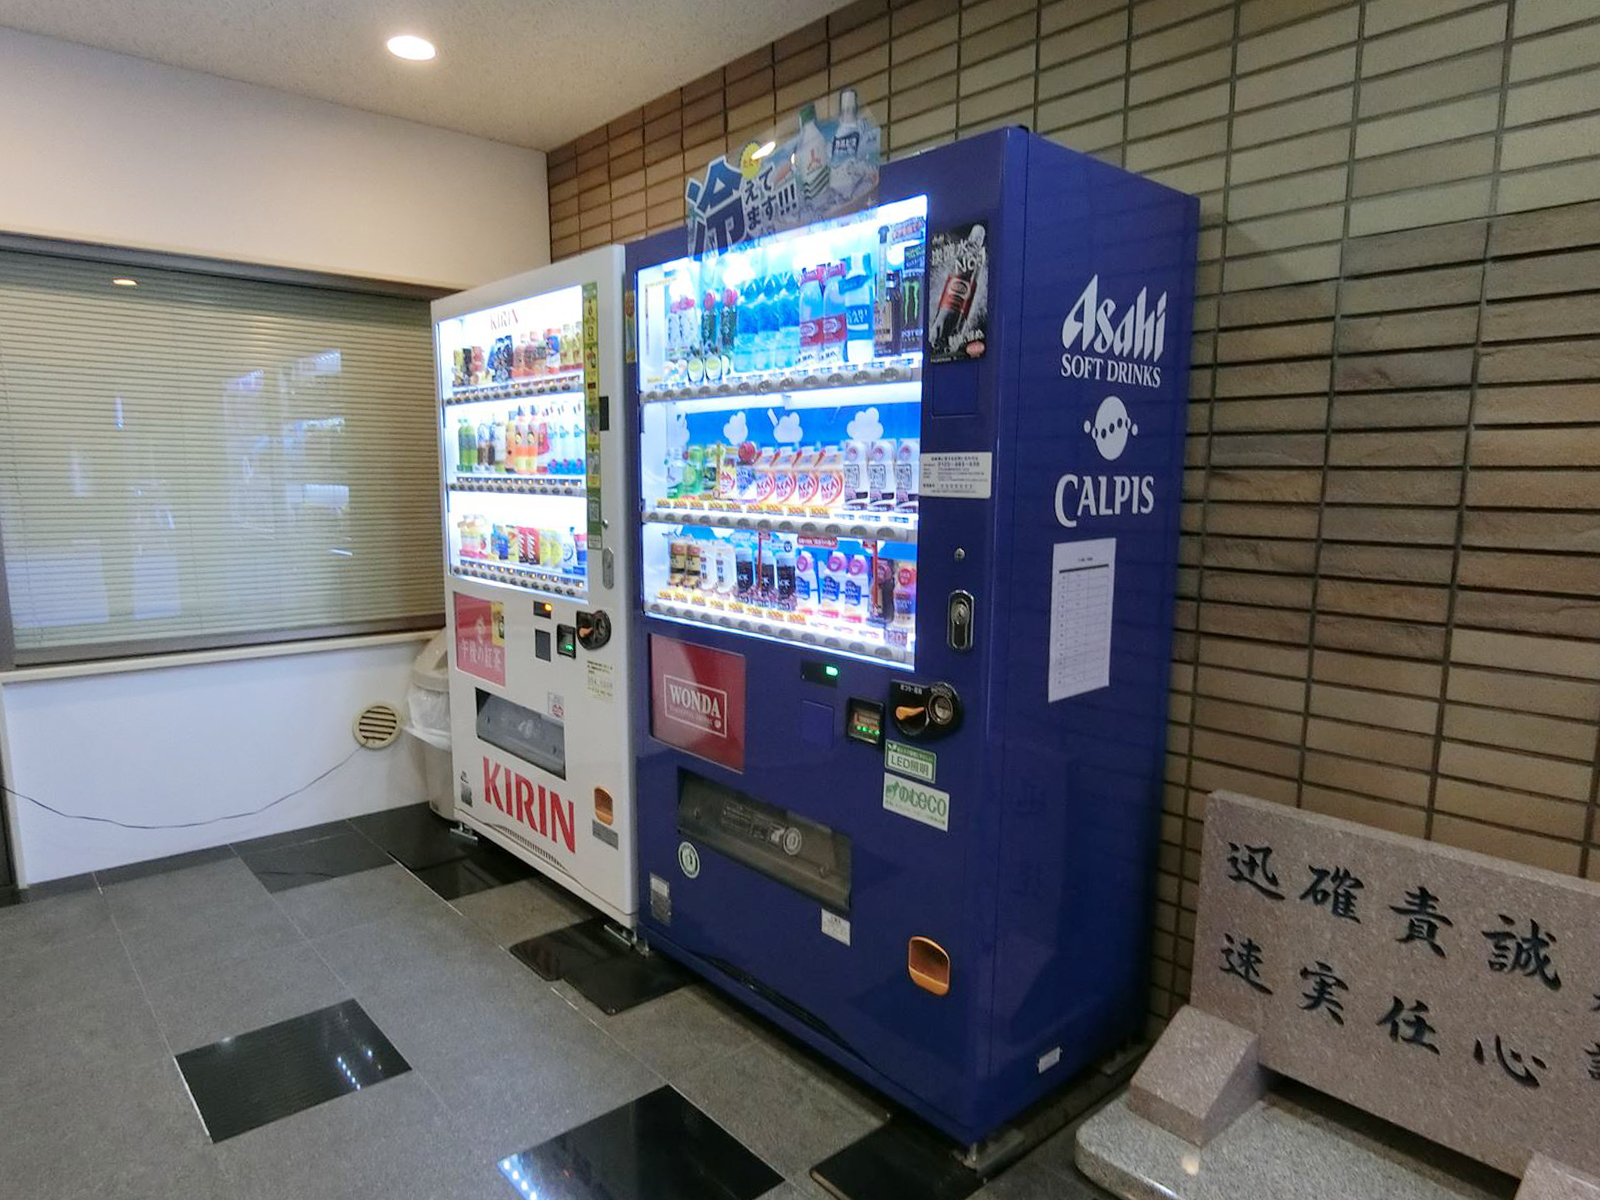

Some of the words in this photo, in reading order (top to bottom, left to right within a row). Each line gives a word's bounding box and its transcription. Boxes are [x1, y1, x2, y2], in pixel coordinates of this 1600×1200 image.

[1061, 273, 1168, 362] Asahi
[1061, 353, 1104, 381] SOFT
[1106, 359, 1162, 388] DRINKS
[1054, 473, 1155, 528] CALPIS
[669, 683, 721, 719] WONDA
[482, 755, 576, 855] KIRIN
